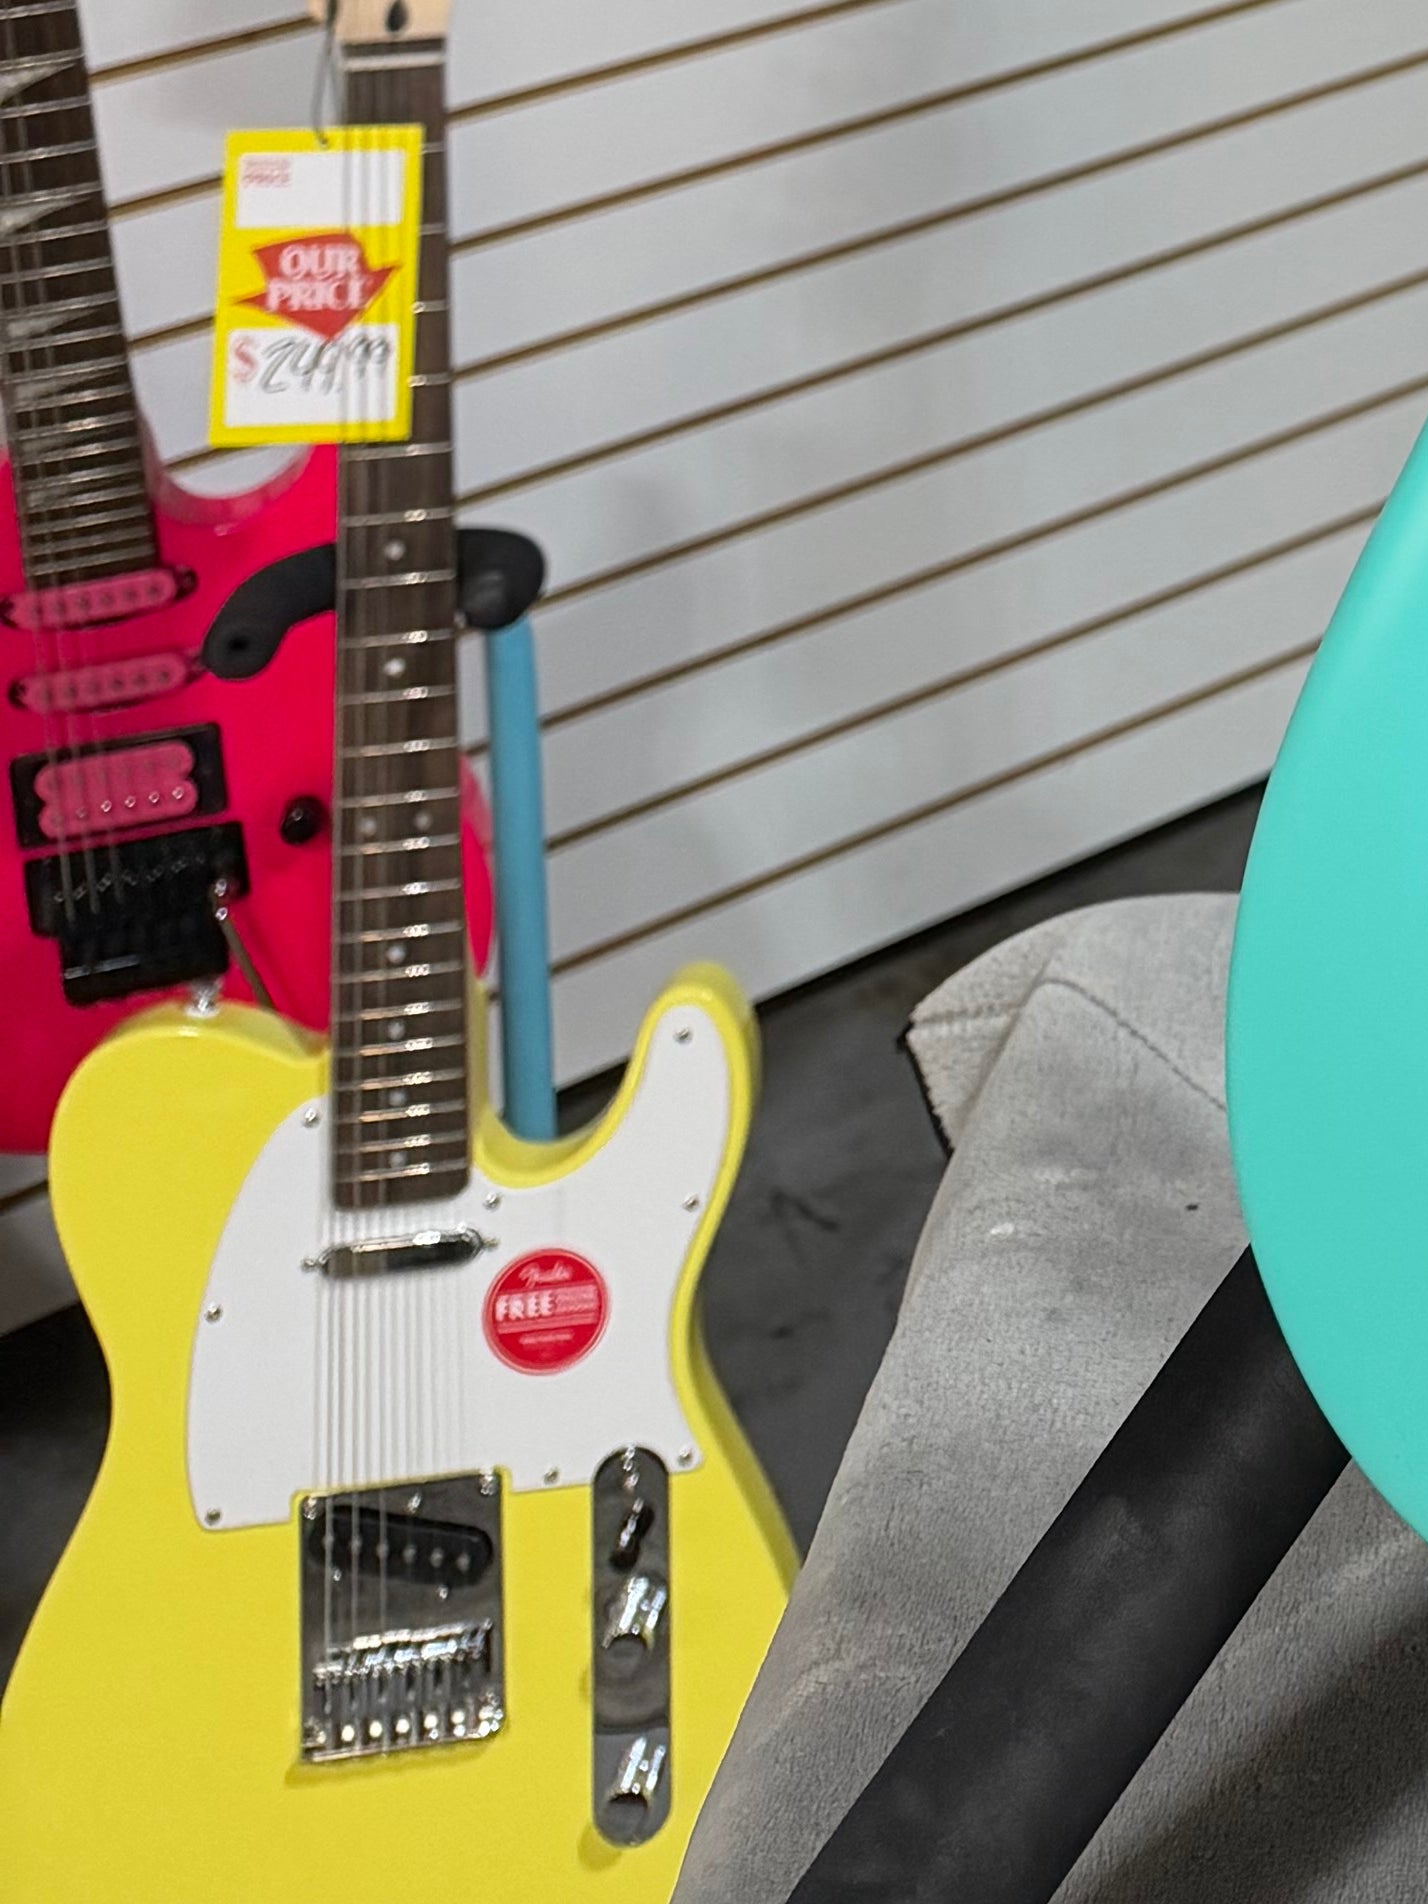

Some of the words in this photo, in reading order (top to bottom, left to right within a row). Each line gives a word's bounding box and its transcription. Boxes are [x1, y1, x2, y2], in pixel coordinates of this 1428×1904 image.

[278, 243, 363, 281] OUR
[266, 277, 371, 312] PRICE
[494, 1289, 554, 1322] FREE
